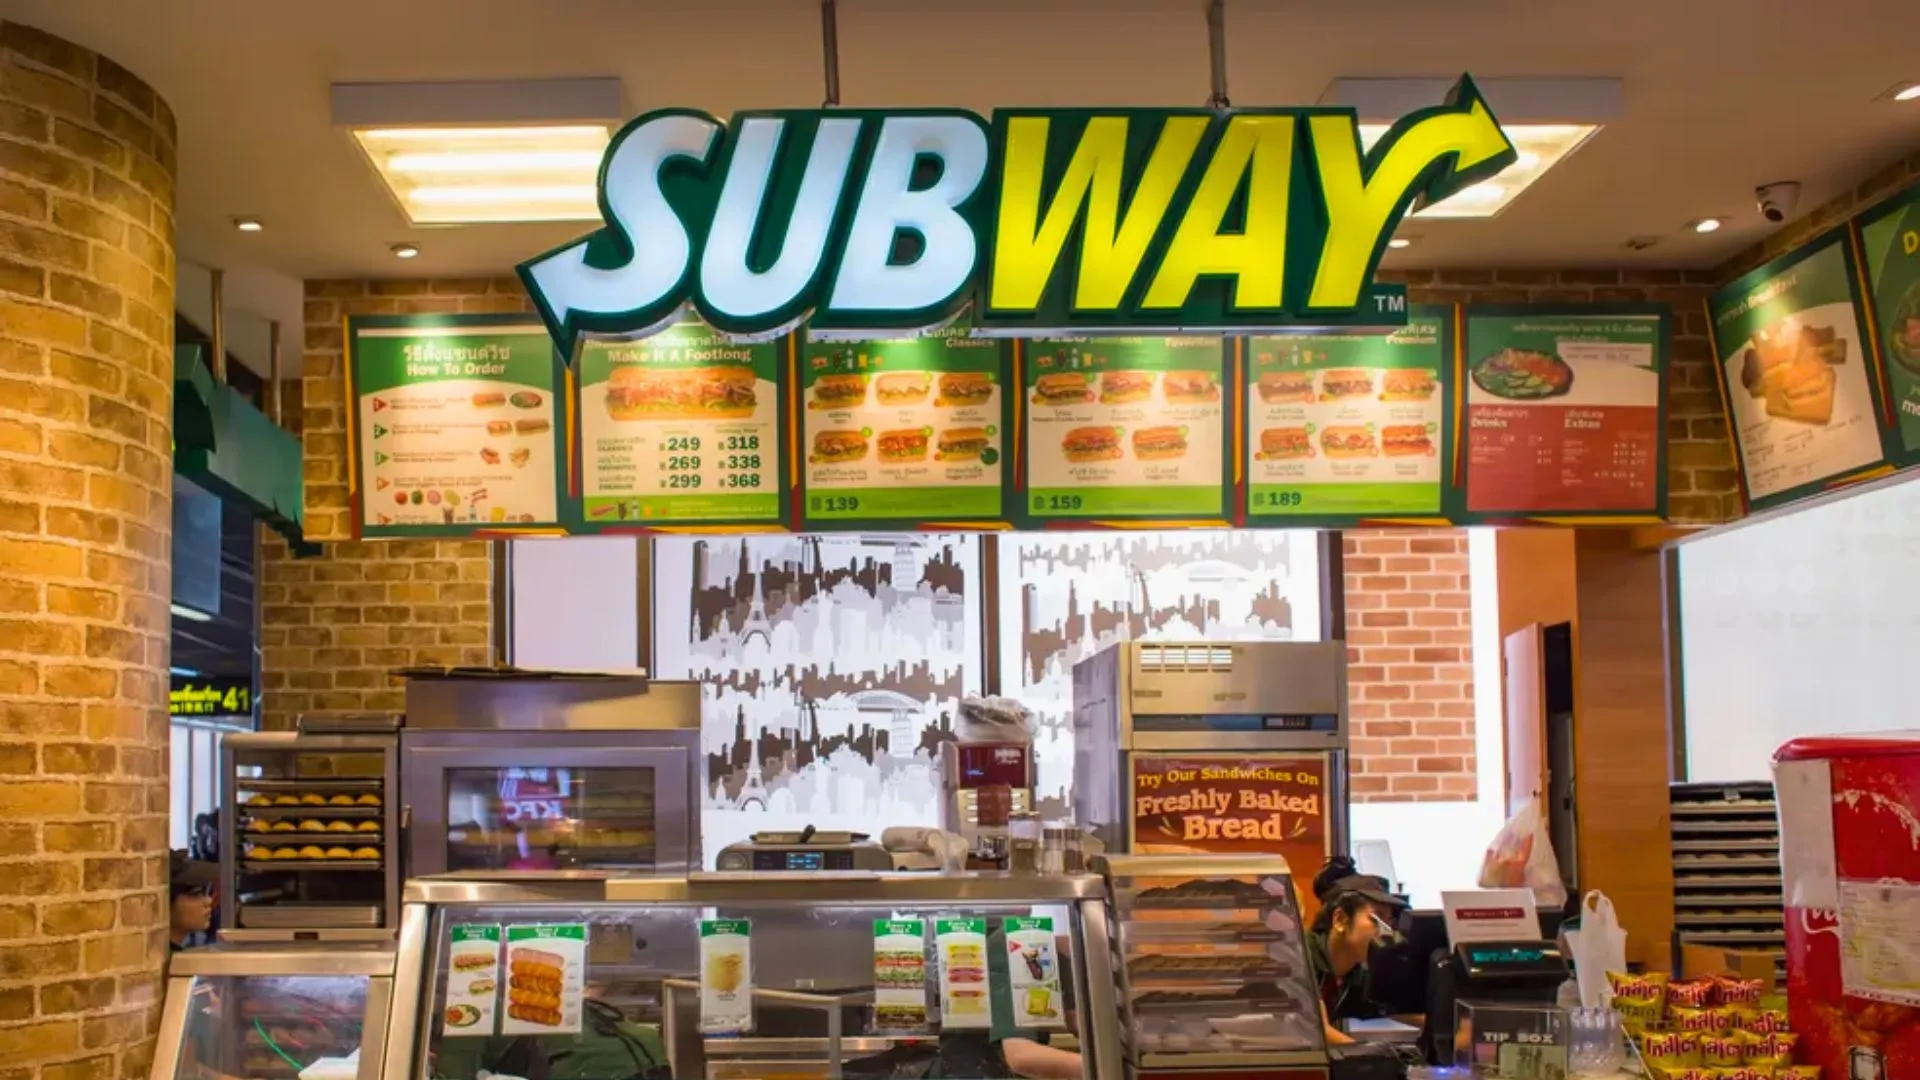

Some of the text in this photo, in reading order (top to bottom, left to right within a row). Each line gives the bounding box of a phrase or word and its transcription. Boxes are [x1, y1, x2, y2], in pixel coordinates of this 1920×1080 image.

[528, 97, 1511, 326] SUBWAY
[1373, 294, 1404, 313] TM
[608, 350, 649, 363] Make
[669, 350, 680, 362] A
[685, 348, 753, 363] Footlong
[407, 361, 506, 376] How To Order
[1471, 417, 1508, 429] Drinks
[1564, 418, 1601, 429] Extras
[668, 435, 760, 451] 249 318
[668, 455, 761, 470] 269 338
[669, 473, 761, 488] 299 368
[825, 496, 859, 511] 139
[1050, 495, 1083, 510] 159
[1269, 492, 1302, 506] 189
[222, 686, 249, 712] 41
[1137, 766, 1319, 789] Try Our Sandwiches On
[1136, 788, 1319, 816] Freshly Baked
[1182, 813, 1283, 841] Bread
[1483, 1031, 1554, 1044] TIP BOX
